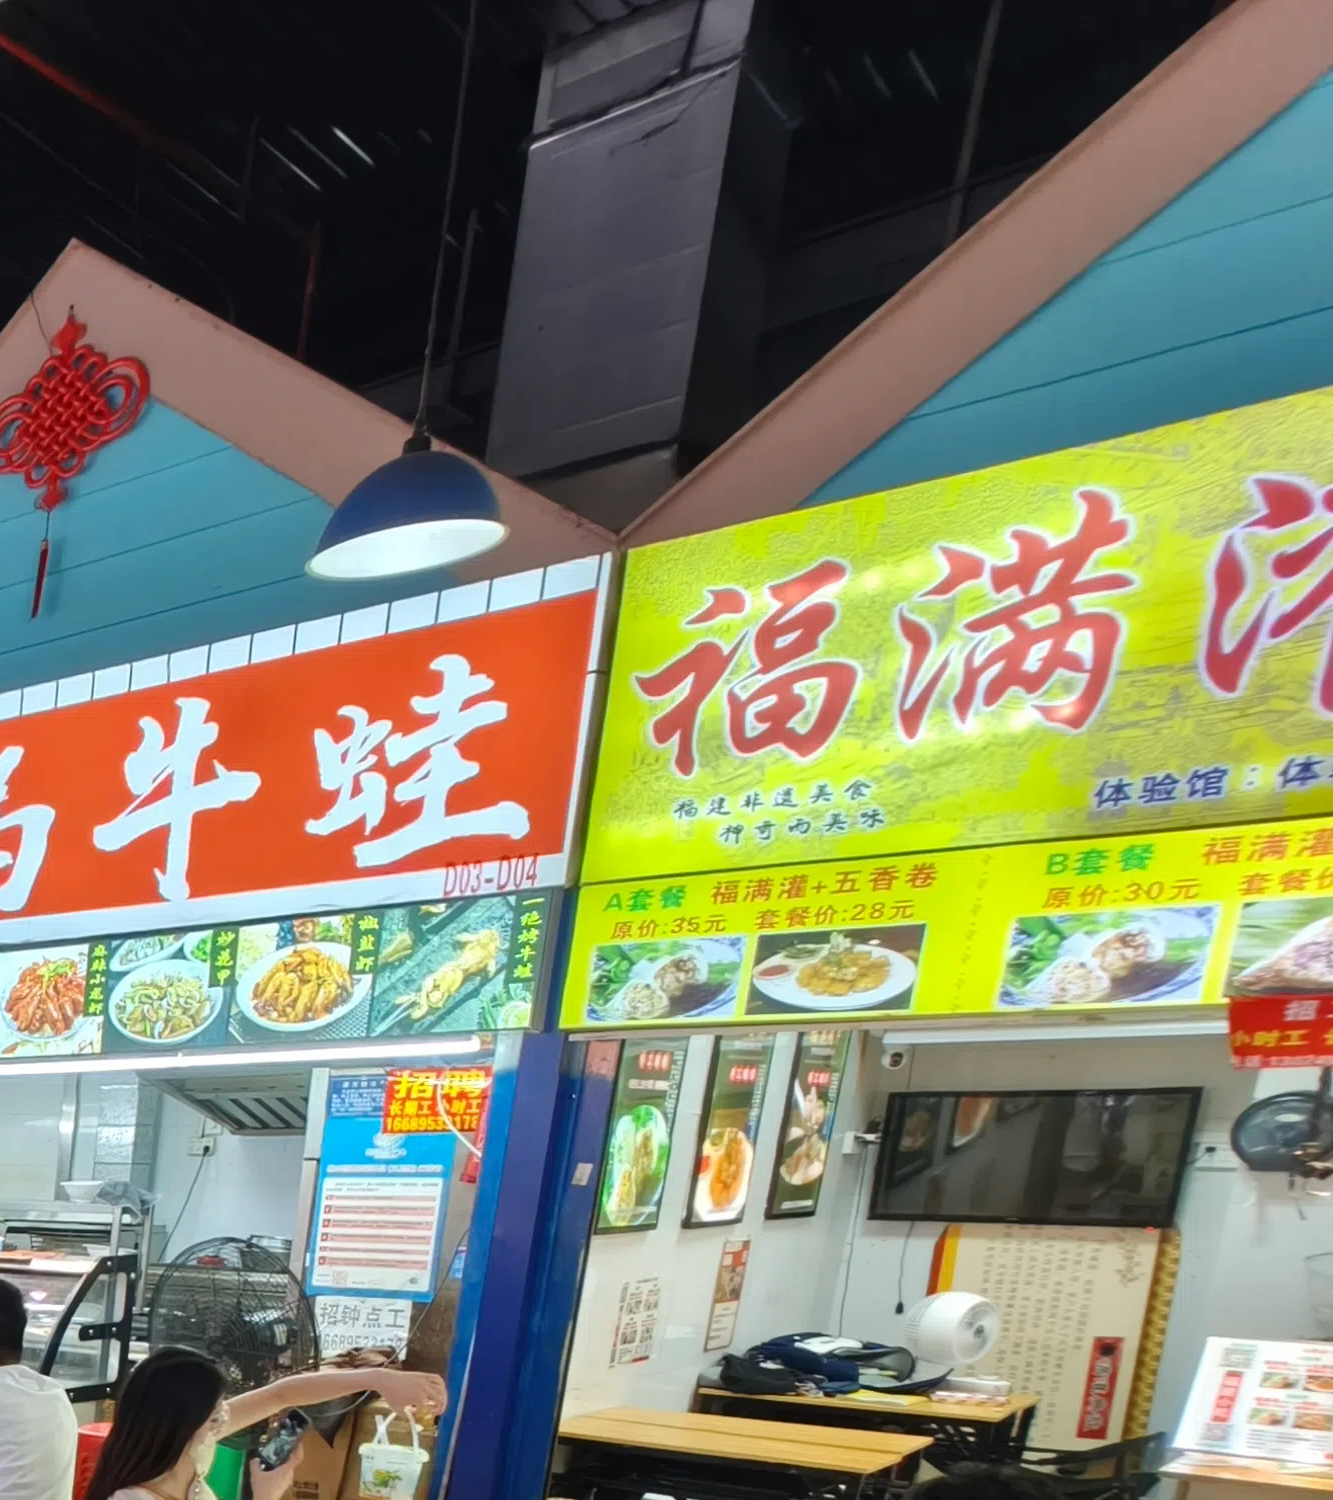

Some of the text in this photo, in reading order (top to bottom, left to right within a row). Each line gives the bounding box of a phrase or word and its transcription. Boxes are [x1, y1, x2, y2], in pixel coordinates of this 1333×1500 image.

[673, 778, 872, 820] 福建非遗美食
[1092, 755, 1333, 809] 体验馆：体
[442, 854, 539, 898] D03-D04
[1044, 843, 1155, 876] B套餐
[603, 862, 939, 913] A套餐 福满灌+五香卷
[1041, 876, 1202, 909] 原价:30元
[610, 899, 916, 940] 原价:35元 套餐价:28元
[393, 1070, 487, 1099] 招聘
[319, 1301, 406, 1330] 招钟点工
